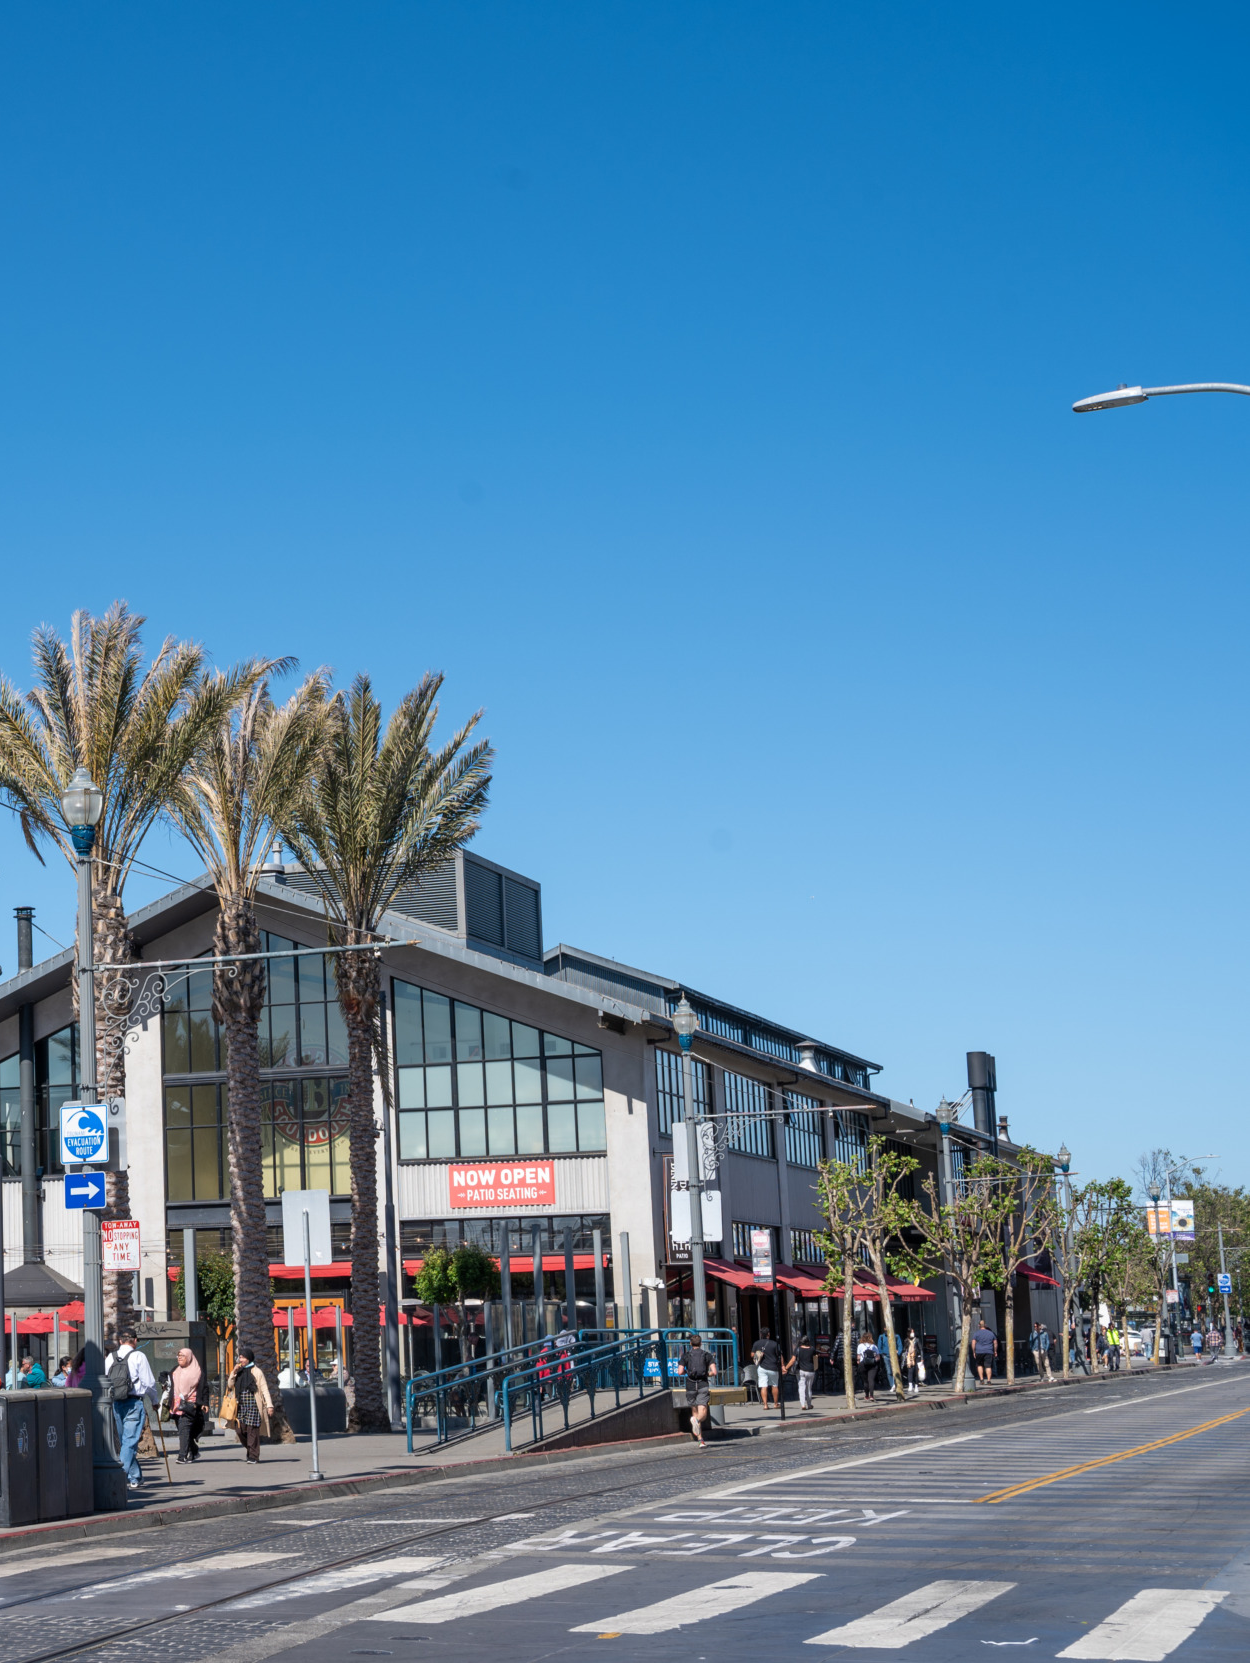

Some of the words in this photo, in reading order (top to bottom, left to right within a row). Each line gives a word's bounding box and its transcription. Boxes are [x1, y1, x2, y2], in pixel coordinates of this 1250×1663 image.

[67, 1136, 101, 1147] EVACUATION
[76, 1147, 93, 1155] ROUTE
[453, 1169, 496, 1187] NOW
[500, 1167, 550, 1184] OPEN
[467, 1189, 495, 1201] PATIO
[497, 1187, 537, 1200] SEATING
[103, 1230, 113, 1241] NO
[114, 1231, 138, 1241] STOPPING
[114, 1243, 129, 1251] ANY
[113, 1252, 131, 1261] TIME
[654, 1507, 913, 1526] KEEP
[503, 1530, 857, 1558] CLEAR
